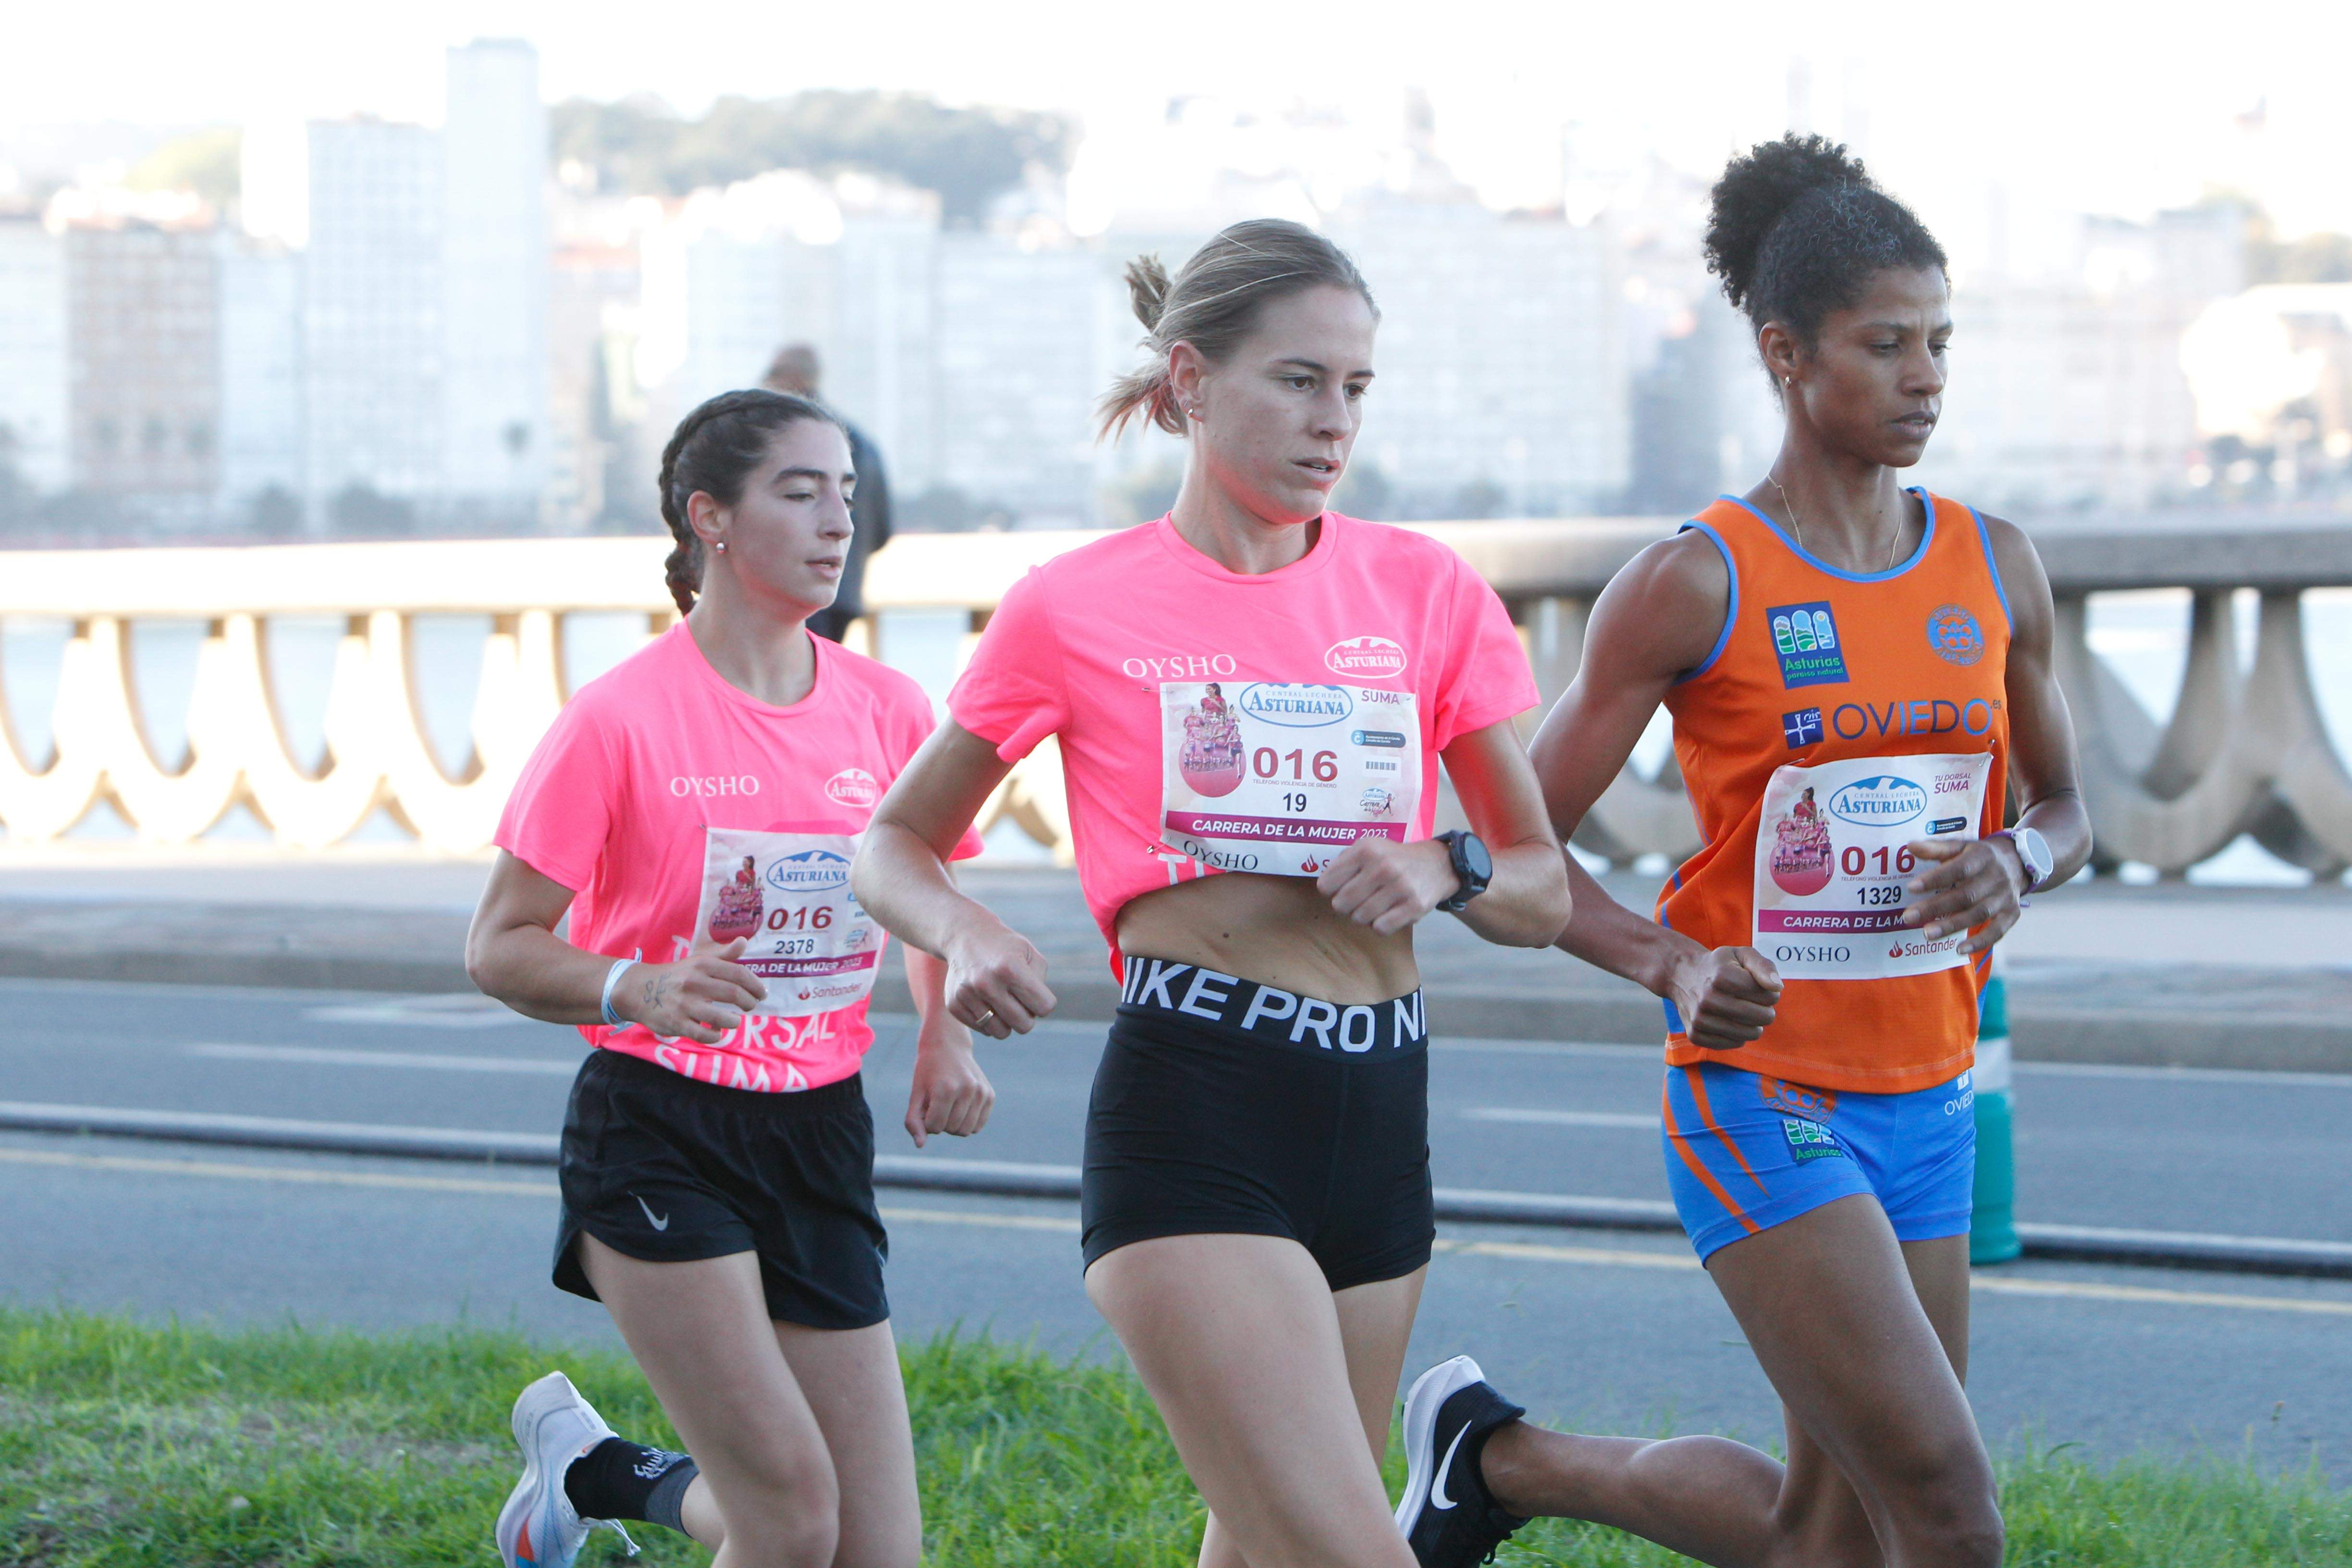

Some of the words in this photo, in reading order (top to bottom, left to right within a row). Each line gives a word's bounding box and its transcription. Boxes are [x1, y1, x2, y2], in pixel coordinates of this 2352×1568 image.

[1123, 654, 1236, 678] OYSHO
[1334, 652, 1401, 668] ASTURIANA
[1785, 656, 1841, 672] Asturias
[1818, 667, 1843, 676] natural
[1249, 691, 1345, 715] ASTURIANA
[1361, 690, 1400, 705] SUMA
[1253, 747, 1338, 782] 016
[670, 775, 760, 797] OYSHO
[1934, 780, 1969, 794] SUMA
[1283, 793, 1307, 812] 19
[1838, 794, 1921, 813] ASTURIANA
[1192, 820, 1261, 835] CARRERA
[1264, 824, 1285, 836] DE
[1287, 825, 1305, 837] LA
[1308, 827, 1357, 840] MUJER
[1360, 828, 1388, 839] 2023
[1184, 841, 1258, 870] OYSHO
[1841, 845, 1915, 876] 016
[773, 865, 846, 882] ASTURIANA
[1857, 885, 1901, 905] 1329
[768, 906, 833, 931] 016
[1783, 917, 1850, 928] CARRERA
[1853, 917, 1873, 928] DE
[1876, 916, 1891, 927] LA
[774, 939, 814, 954] 2378
[1776, 945, 1850, 962] OYSHO
[1905, 938, 1958, 956] Santander
[769, 963, 785, 973] DE
[787, 963, 801, 973] LA
[803, 961, 839, 973] MUJER
[812, 983, 862, 998] Santander
[1240, 985, 1375, 1053] PRO
[1796, 1147, 1841, 1161] Asturias
